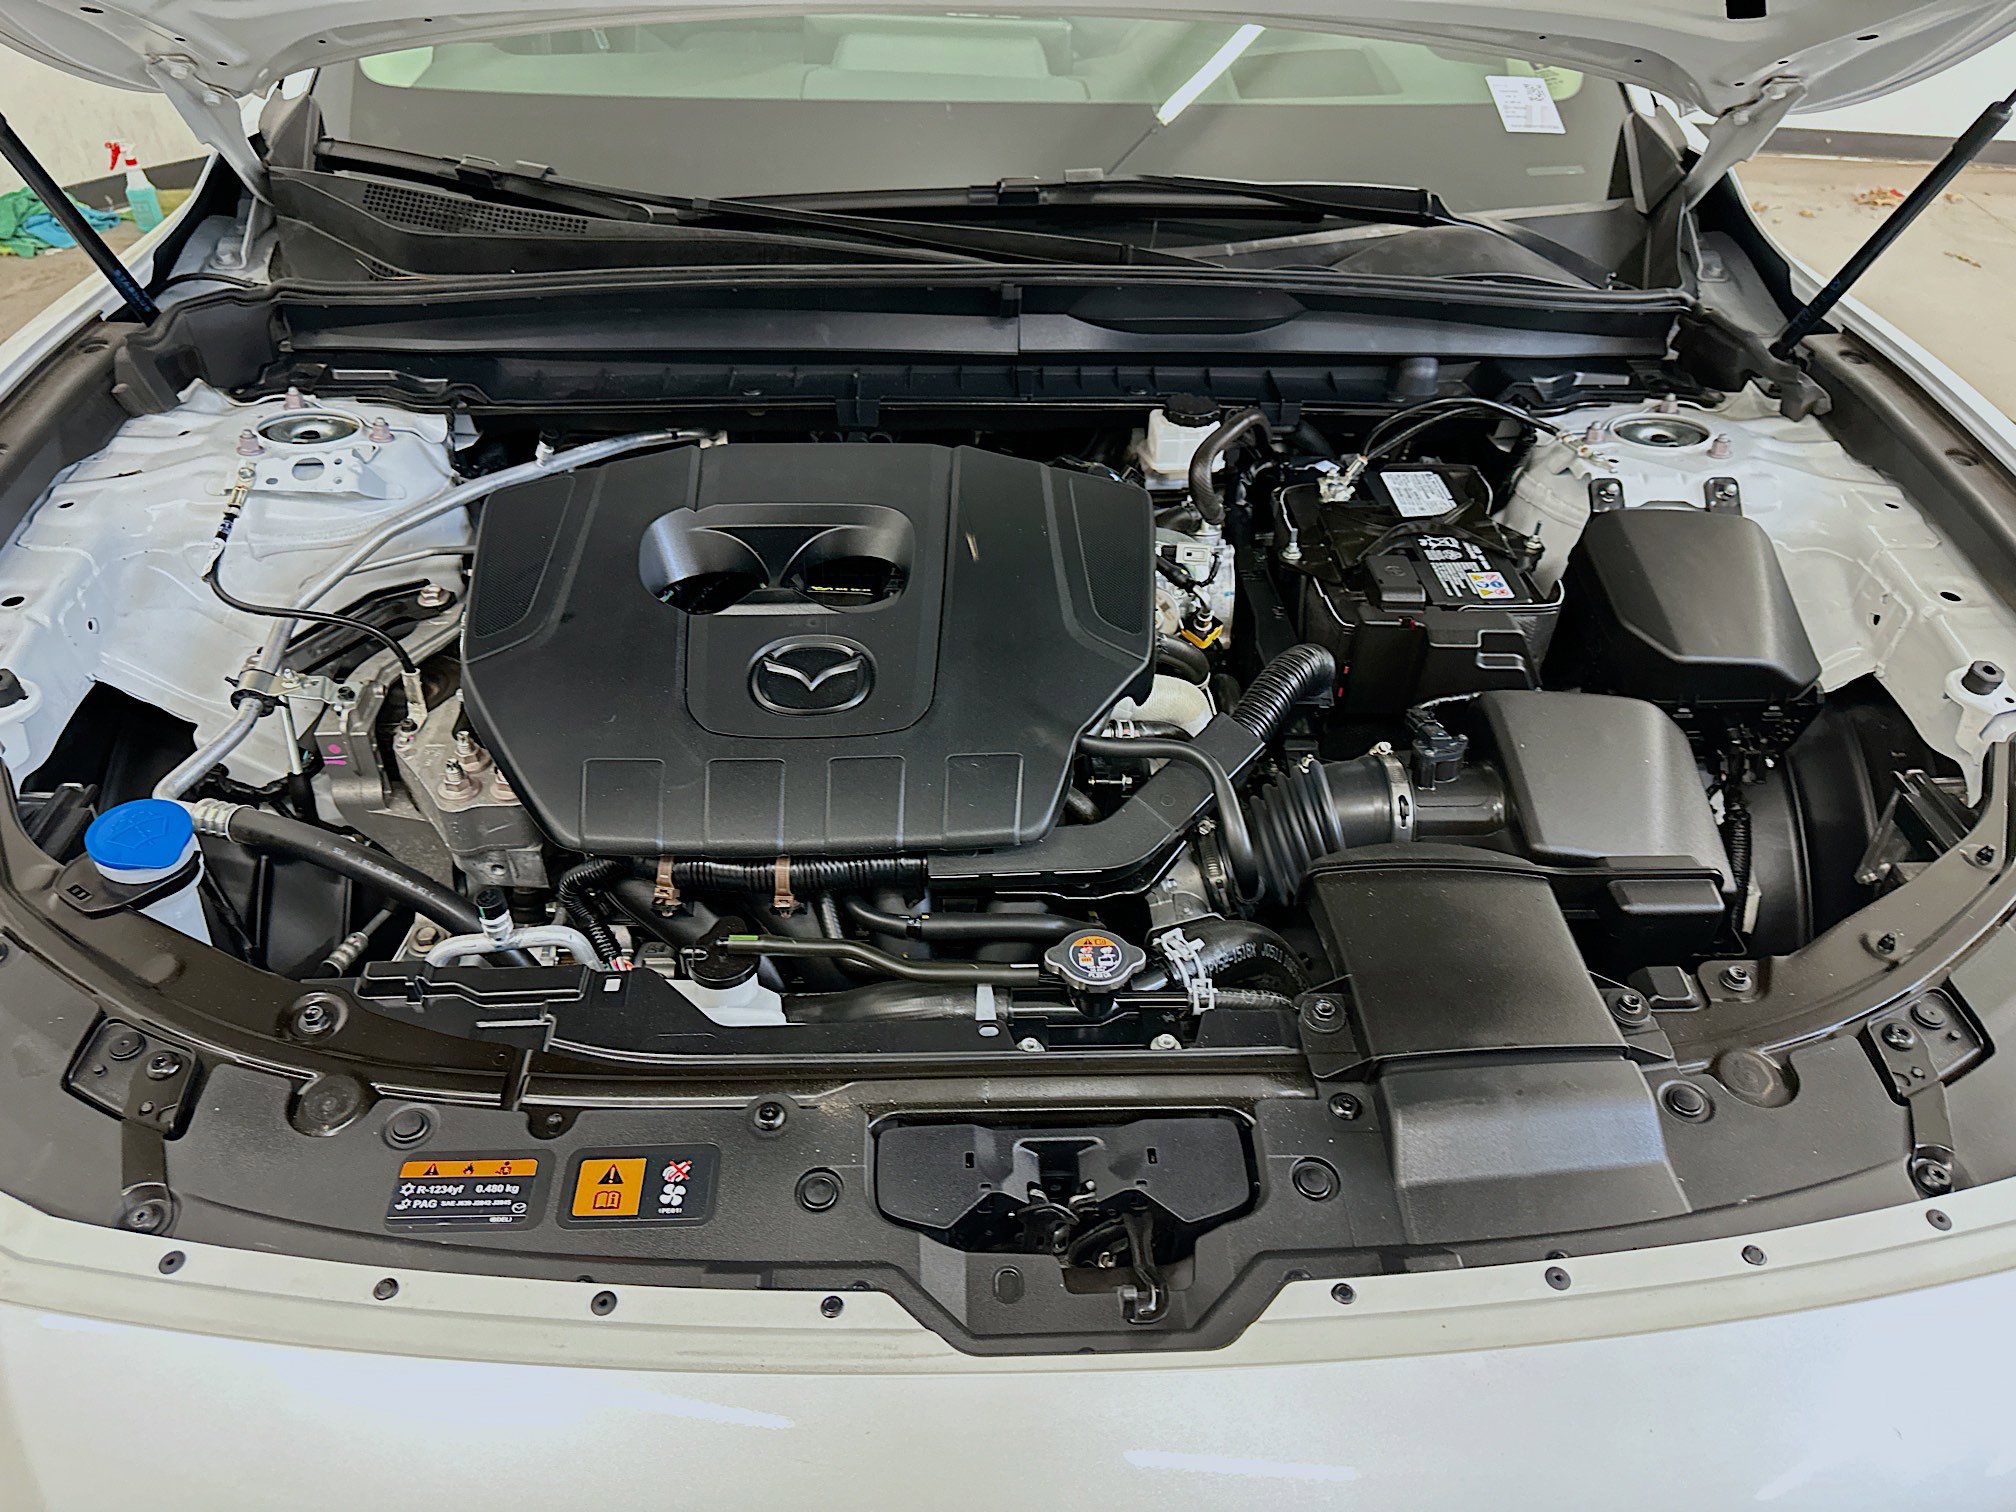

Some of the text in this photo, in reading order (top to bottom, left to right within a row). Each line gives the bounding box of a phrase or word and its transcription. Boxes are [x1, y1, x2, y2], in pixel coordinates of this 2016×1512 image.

[416, 1184, 464, 1196] R-1234yf
[505, 1183, 520, 1195] kg
[412, 1199, 438, 1209] PAG
